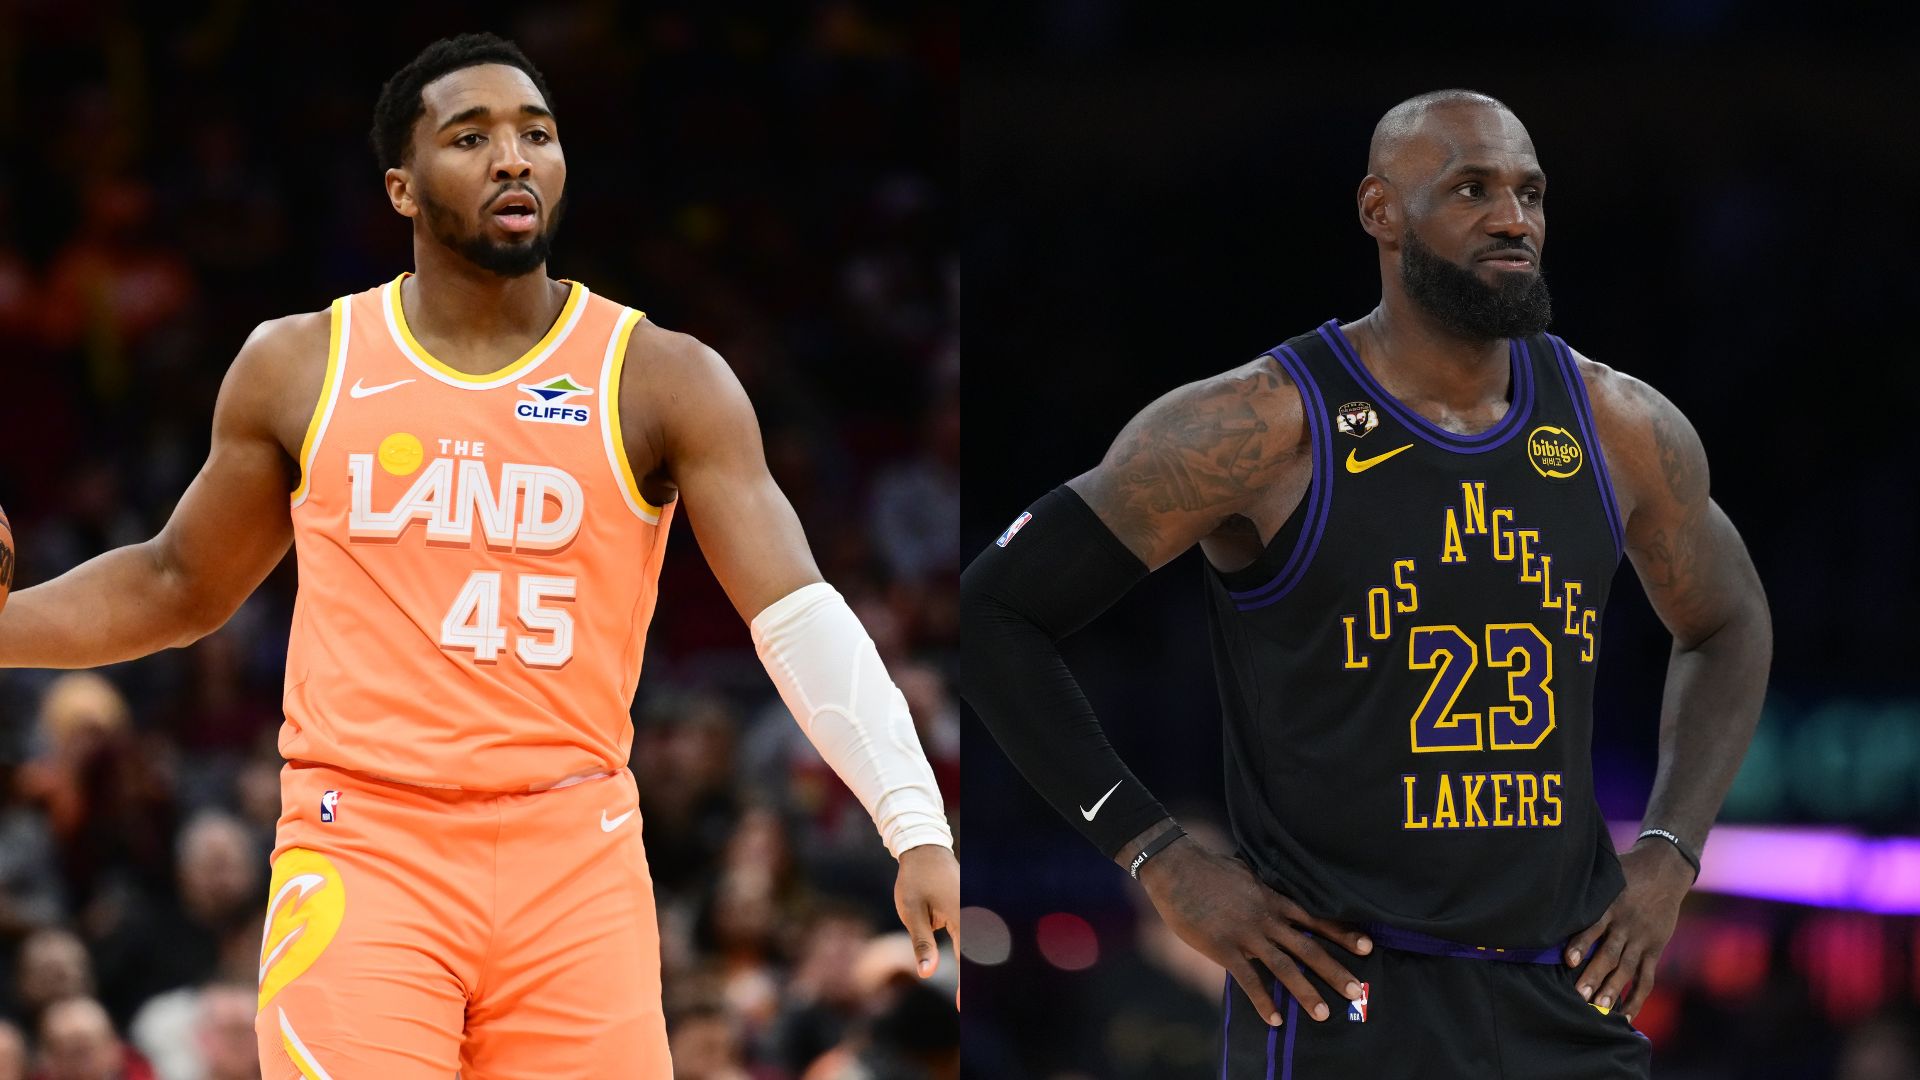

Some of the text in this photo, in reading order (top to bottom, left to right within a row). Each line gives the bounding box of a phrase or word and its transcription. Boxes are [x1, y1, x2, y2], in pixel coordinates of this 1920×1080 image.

[438, 438, 485, 457] THE
[517, 404, 588, 422] CLIFFS
[1532, 439, 1579, 464] bibigo
[348, 453, 584, 555] LAND
[1341, 480, 1597, 670] LOS ANGELES
[440, 570, 577, 669] 45
[1408, 622, 1556, 753] 23
[1402, 772, 1564, 830] LAKERS
